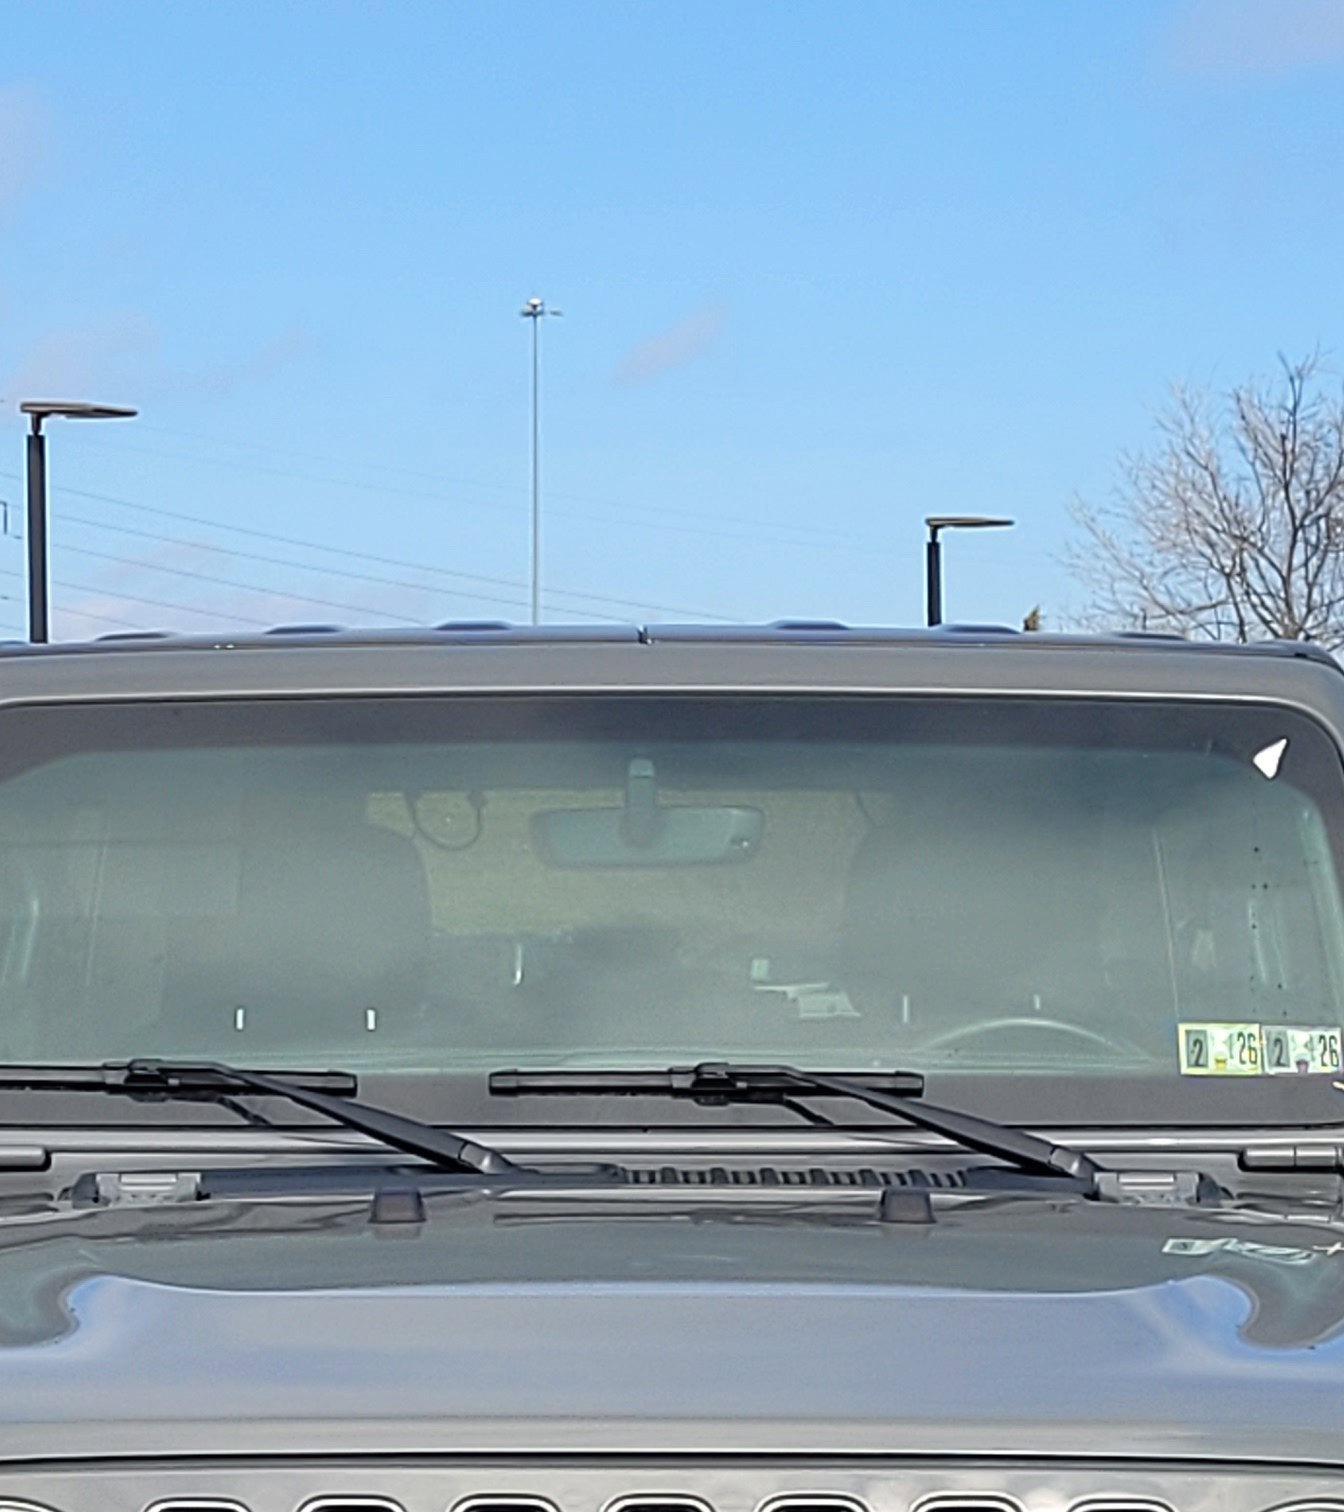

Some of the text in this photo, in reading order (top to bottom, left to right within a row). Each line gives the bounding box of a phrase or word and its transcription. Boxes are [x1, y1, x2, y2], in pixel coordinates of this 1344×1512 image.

[1193, 1031, 1257, 1067] 2 26
[1273, 1034, 1340, 1067] 2 26
